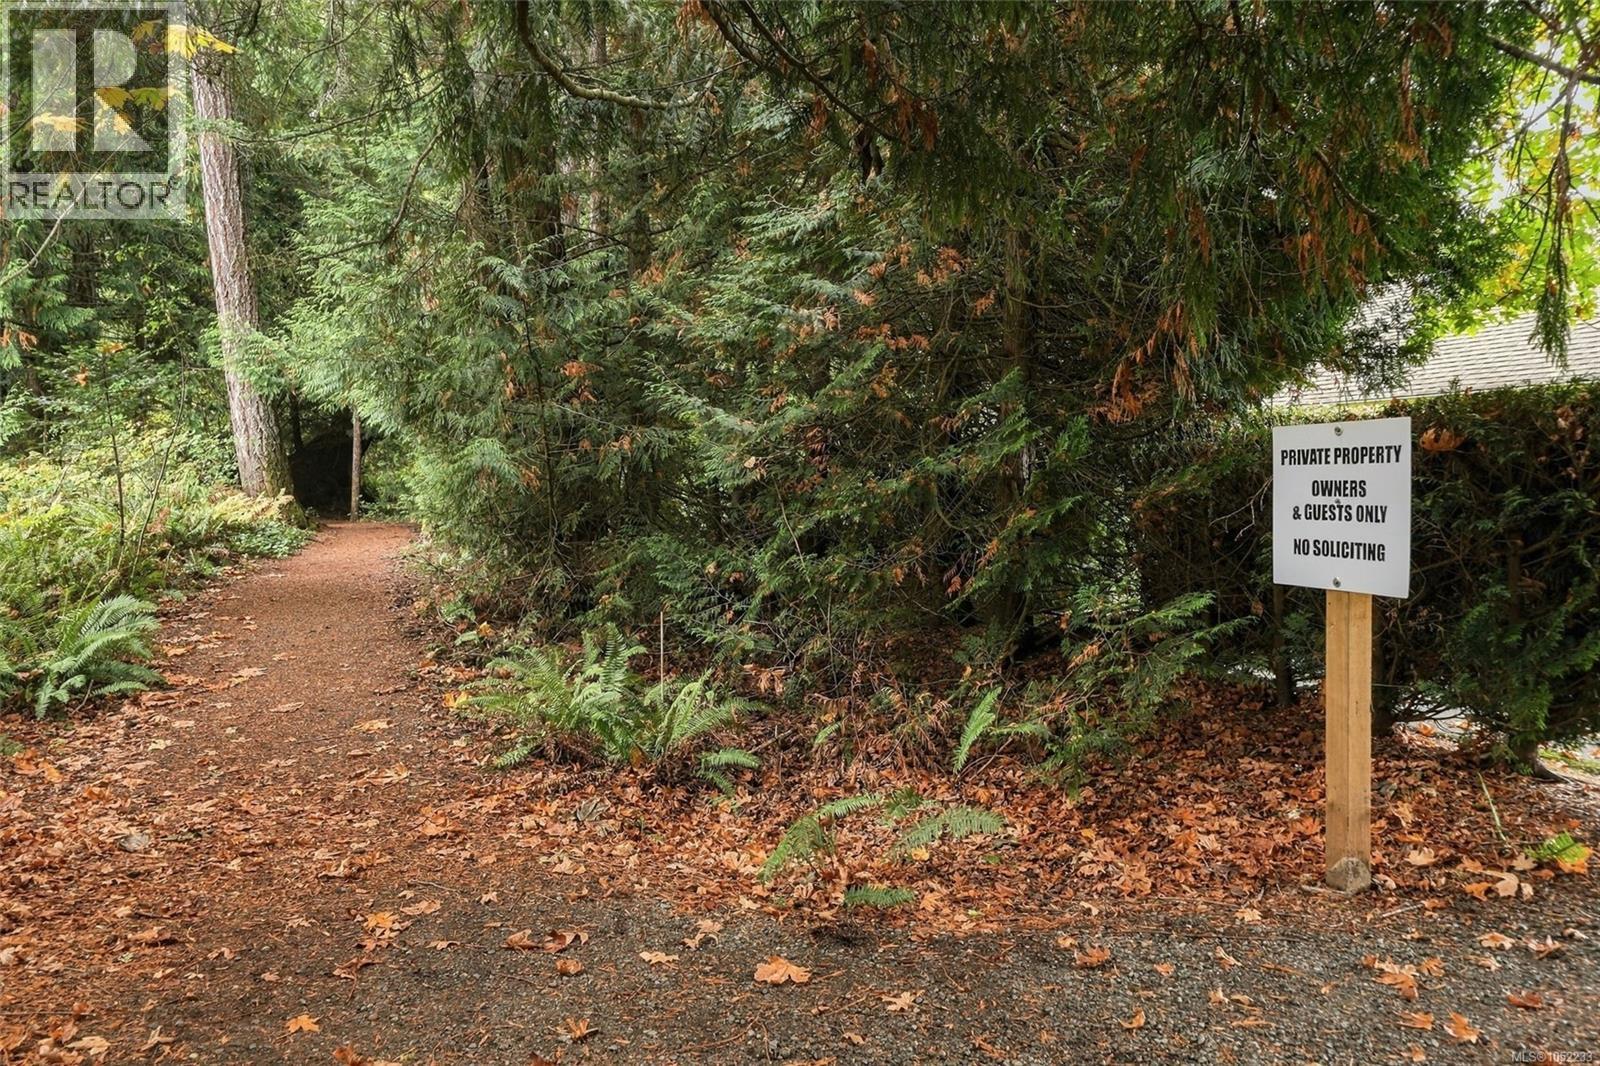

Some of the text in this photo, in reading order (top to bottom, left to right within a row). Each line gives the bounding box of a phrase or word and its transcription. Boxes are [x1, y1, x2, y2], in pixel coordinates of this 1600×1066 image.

[1281, 445, 1402, 465] PRIVATE PROPERTY
[1312, 480, 1367, 497] OWNERS
[1293, 504, 1387, 523] & GUESTS ONLY
[1294, 539, 1385, 561] NO SOLICITING
